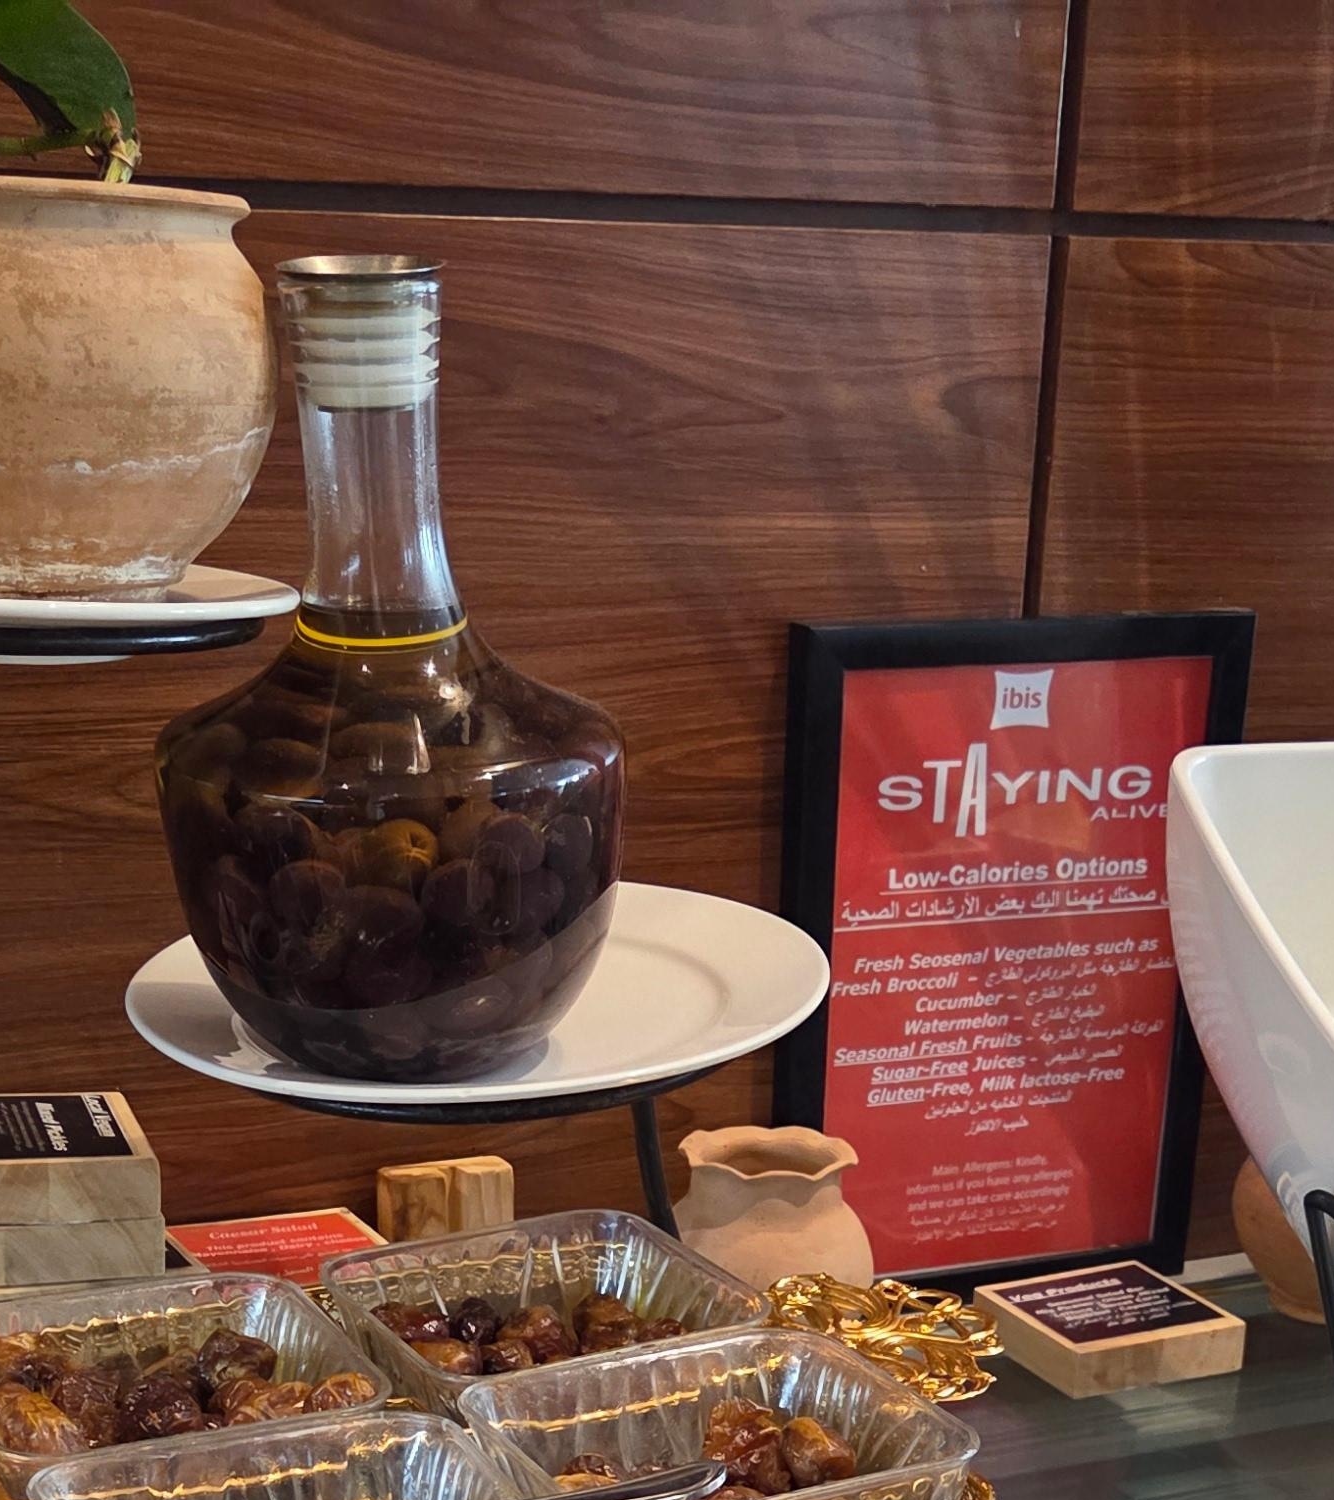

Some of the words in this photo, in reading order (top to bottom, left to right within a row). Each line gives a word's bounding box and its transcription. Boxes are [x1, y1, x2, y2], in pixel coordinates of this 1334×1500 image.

[1001, 687, 1042, 709] ibis
[878, 743, 1152, 837] STAYING
[888, 861, 1048, 890] Low-Calories
[1055, 858, 1148, 882] Options
[842, 901, 900, 927] الصحية
[986, 894, 1025, 916] بعض
[854, 957, 905, 974] Fresh
[994, 942, 1089, 964] Vegetables
[1093, 938, 1135, 956] such
[1138, 940, 1158, 952] as
[831, 981, 880, 998] Fresh
[886, 974, 958, 993] Broccoli
[916, 992, 1003, 1013] Cucumber
[904, 1013, 1008, 1036] Watermelon
[834, 1044, 914, 1064] Seasonal
[919, 1039, 968, 1057] Fresh
[972, 1032, 1022, 1050] Fruits
[871, 1060, 969, 1083] Sugar-Free
[971, 1056, 1026, 1073] Juices
[867, 1083, 974, 1106] Gluten-Free,
[980, 1075, 1015, 1093] Milk
[1020, 1067, 1125, 1089] lactose-Free
[932, 1165, 959, 1176] Main
[966, 1178, 985, 1191] you
[987, 1174, 1010, 1186] have
[1012, 1173, 1031, 1185] any
[1032, 1168, 1074, 1183] allergies
[907, 1199, 927, 1212] and
[928, 1198, 944, 1209] we
[946, 1196, 965, 1207] can
[966, 1193, 988, 1205] take
[990, 1190, 1012, 1202] care
[1013, 1184, 1070, 1200] accordingly
[208, 1228, 268, 1240] Caesar
[271, 1222, 319, 1234] Salad
[1045, 1277, 1123, 1298] Products
